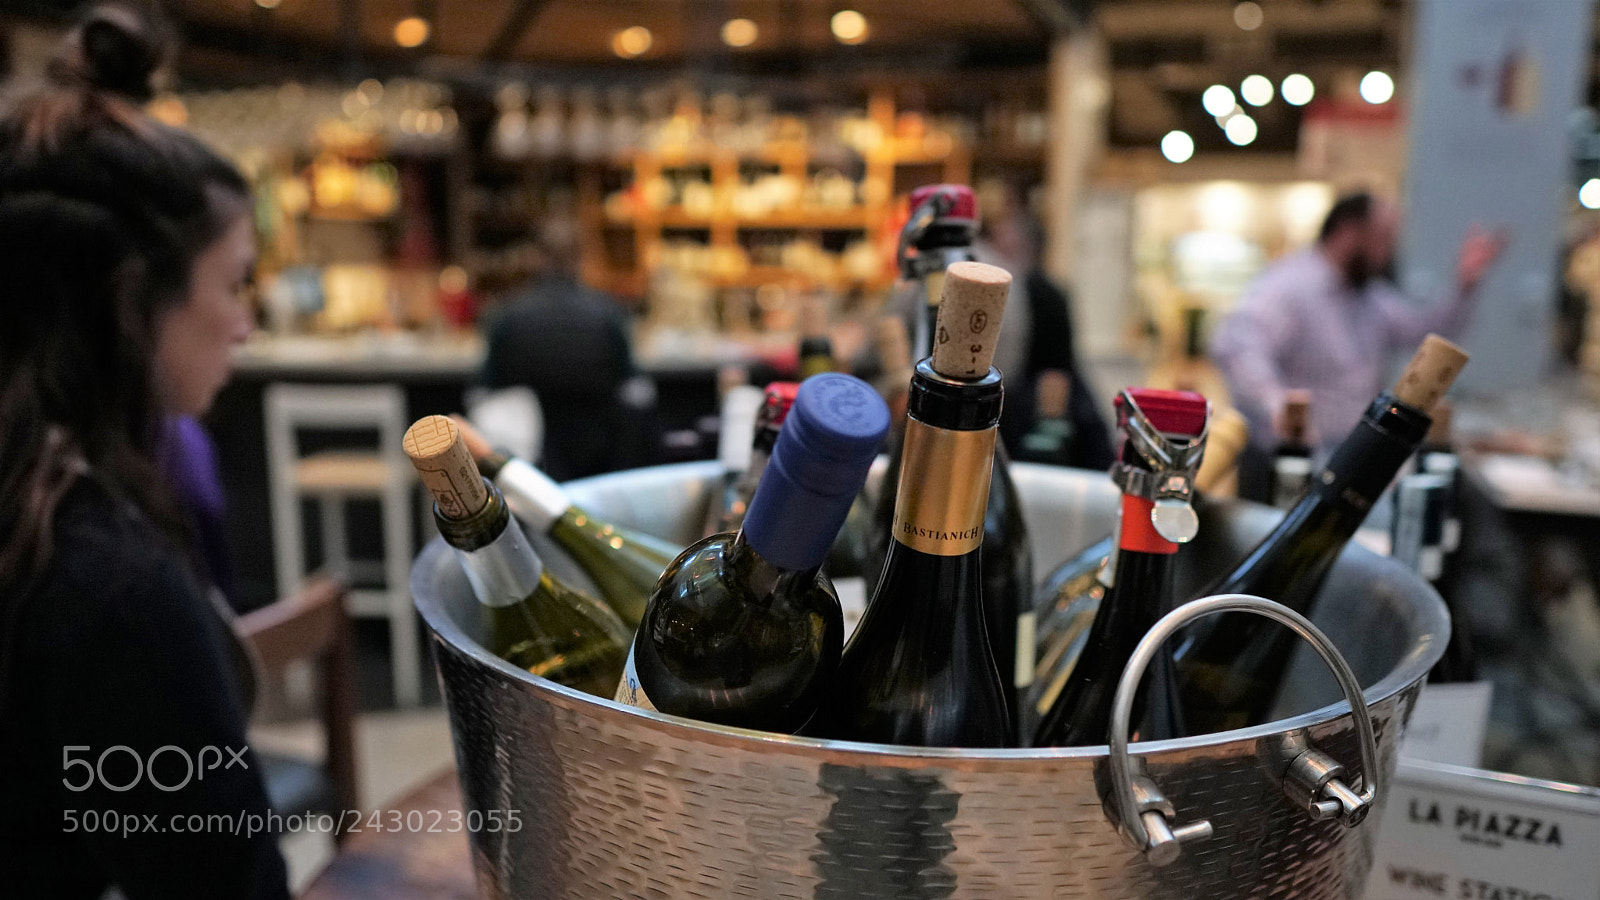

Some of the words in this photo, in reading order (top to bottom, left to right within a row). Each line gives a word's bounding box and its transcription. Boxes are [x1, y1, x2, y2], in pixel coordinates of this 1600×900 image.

[903, 521, 979, 541] BASTIANICH
[1408, 799, 1442, 826] LA
[1454, 805, 1562, 847] PIAZZA
